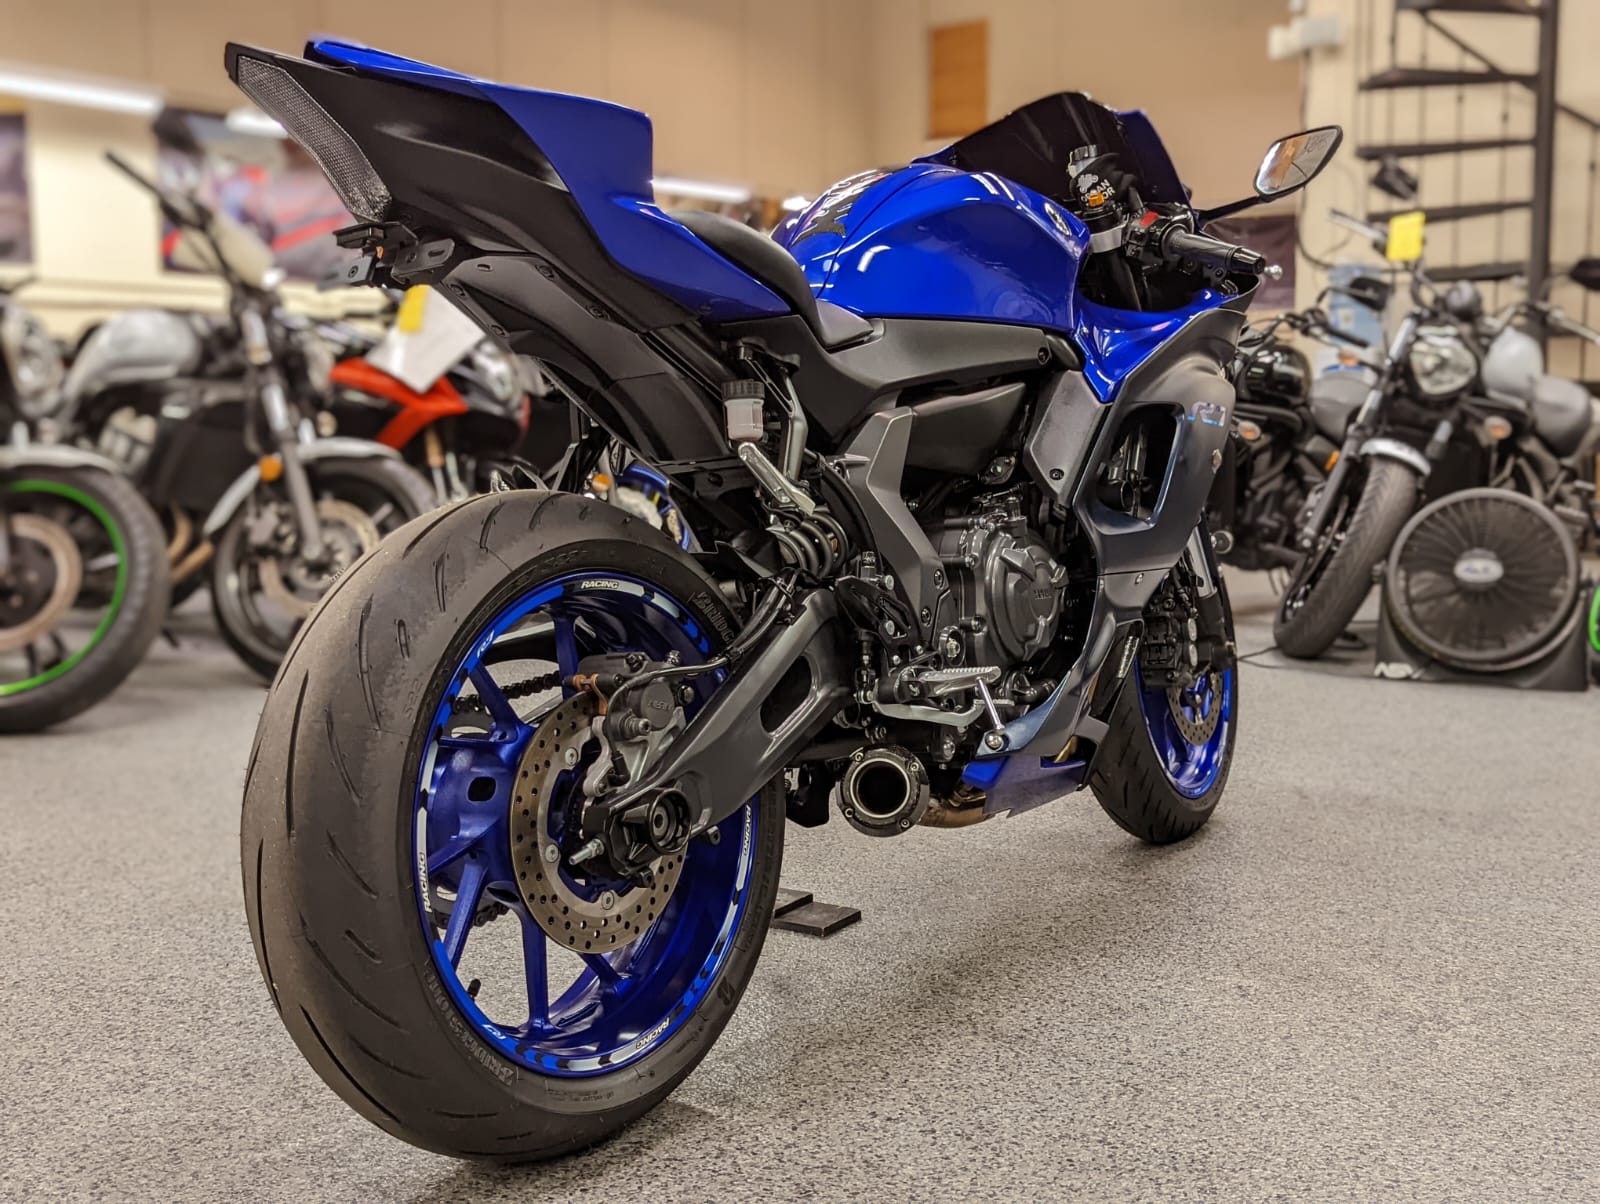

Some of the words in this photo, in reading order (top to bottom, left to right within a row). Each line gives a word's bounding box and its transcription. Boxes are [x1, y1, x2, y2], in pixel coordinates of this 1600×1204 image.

[580, 580, 619, 590] RACING
[692, 591, 735, 643] BRIDG
[743, 804, 752, 856] RACING
[418, 851, 433, 913] RACING
[635, 1016, 670, 1049] RACING
